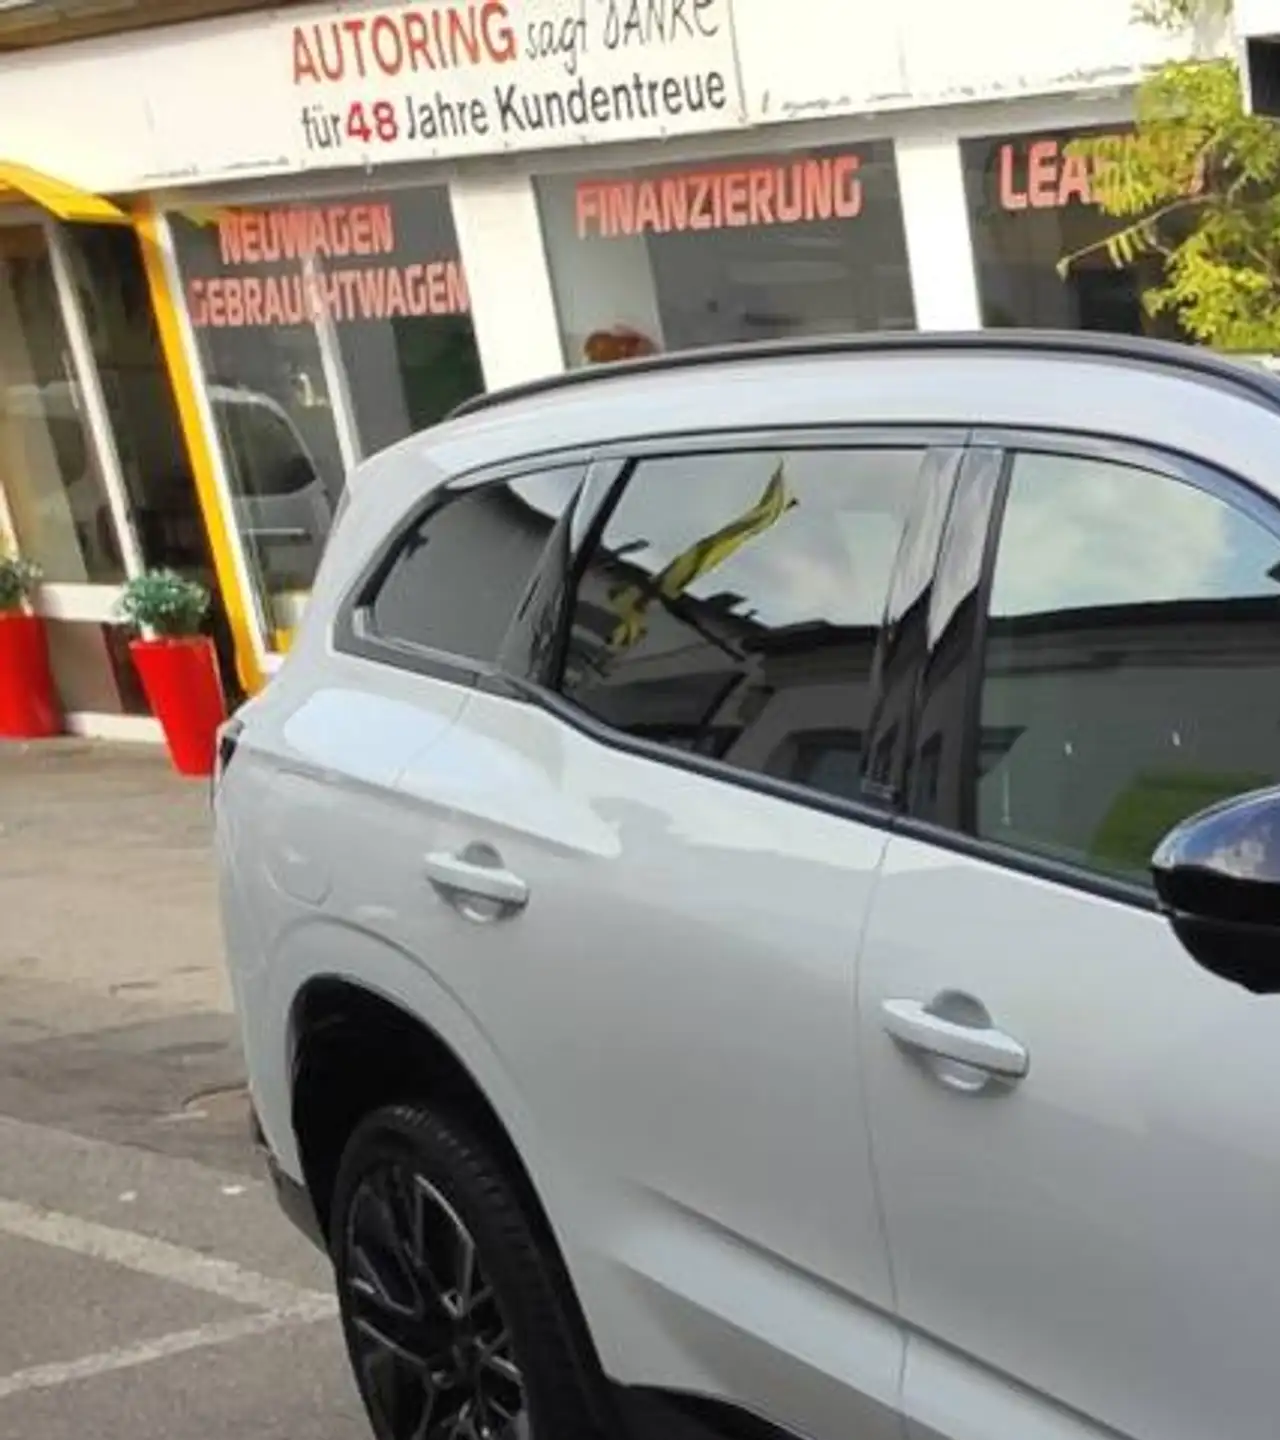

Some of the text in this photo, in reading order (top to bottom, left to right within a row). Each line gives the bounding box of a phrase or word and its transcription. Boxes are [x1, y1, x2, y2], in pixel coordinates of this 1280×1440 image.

[293, 2, 517, 85] AUTORING
[301, 71, 727, 150] für 48 Jahre Kundentreue
[217, 202, 394, 265] NEUWAGEN
[575, 154, 863, 240] FINANZIERUNG
